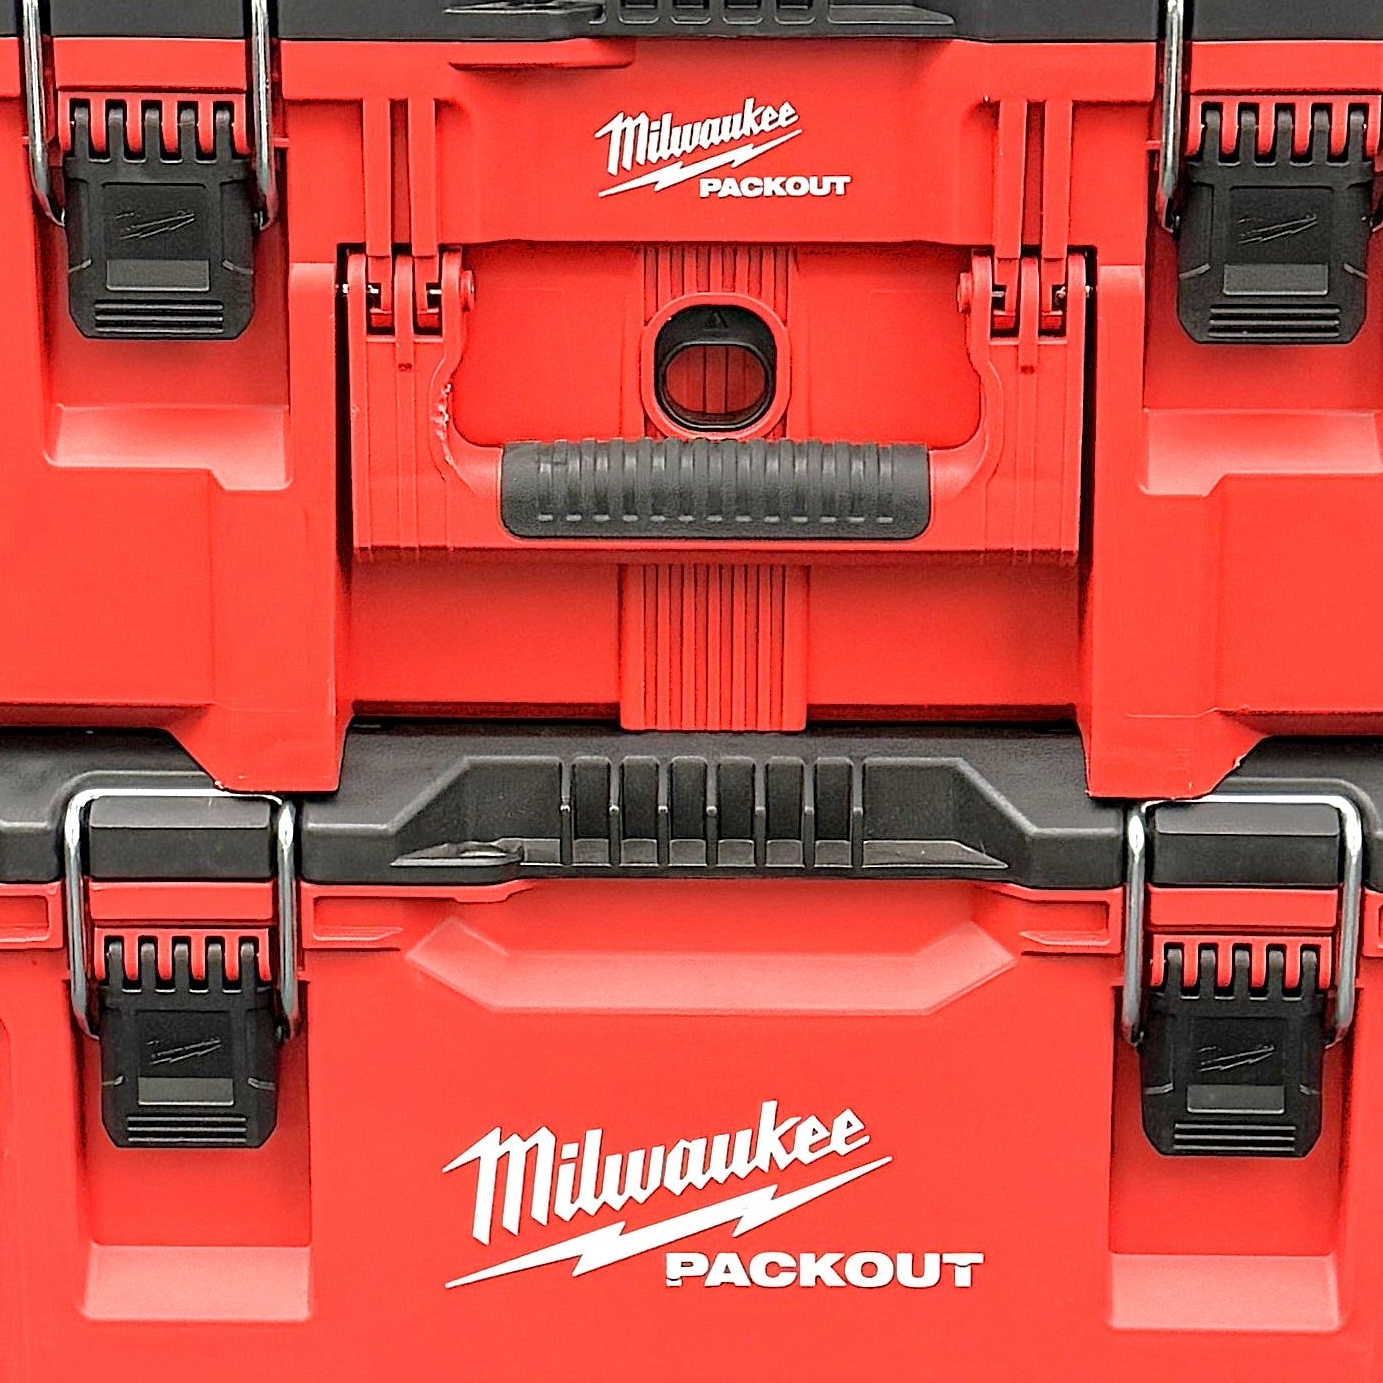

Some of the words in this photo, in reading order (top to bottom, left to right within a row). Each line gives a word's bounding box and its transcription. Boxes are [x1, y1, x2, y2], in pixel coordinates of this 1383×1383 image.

[593, 96, 800, 177] Milwaukee
[698, 174, 853, 199] PACKOUT
[441, 1099, 872, 1247] Milwaukee
[665, 1251, 985, 1288] PACKOUT
